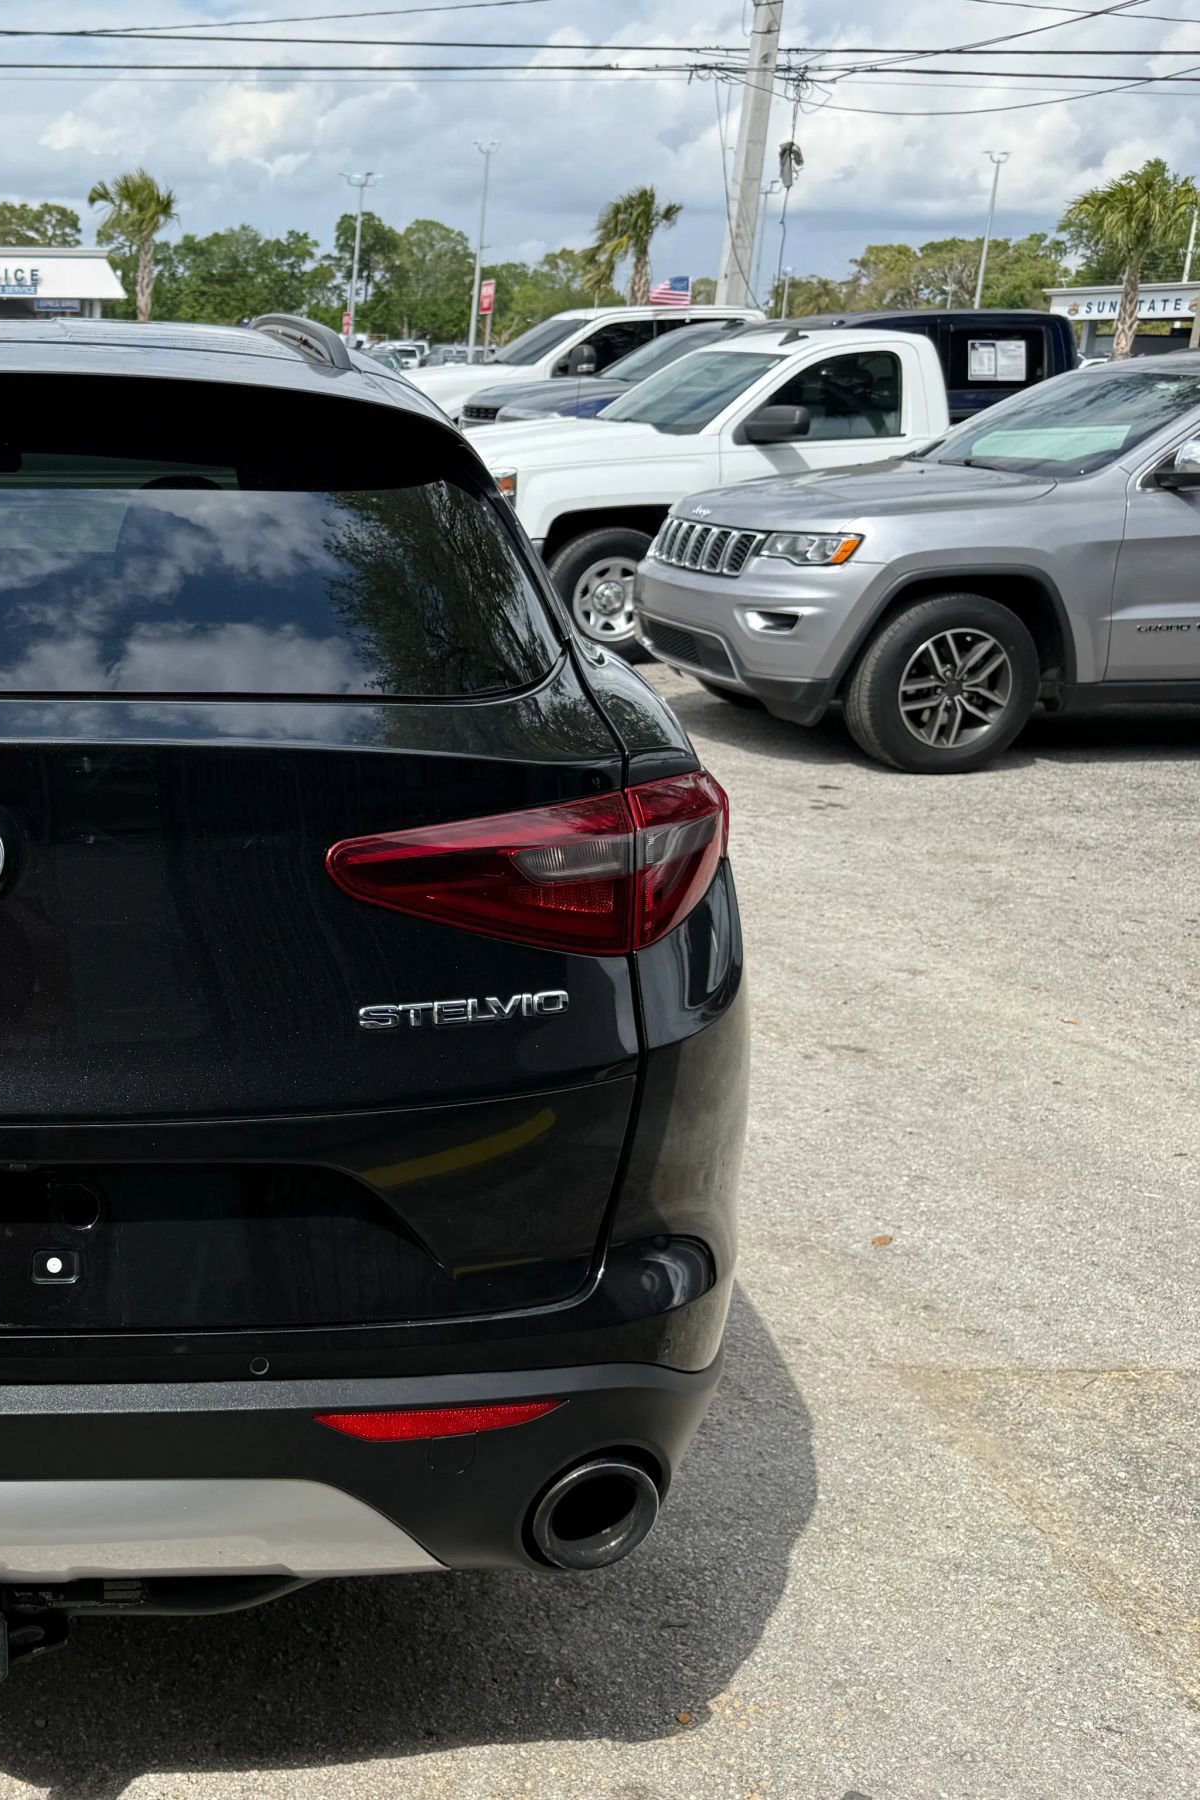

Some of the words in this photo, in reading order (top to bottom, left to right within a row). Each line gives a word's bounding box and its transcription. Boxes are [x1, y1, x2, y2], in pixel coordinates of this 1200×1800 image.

[1085, 300, 1118, 314] SUN
[1136, 297, 1183, 313] TATE
[359, 990, 569, 1030] STELVIO
